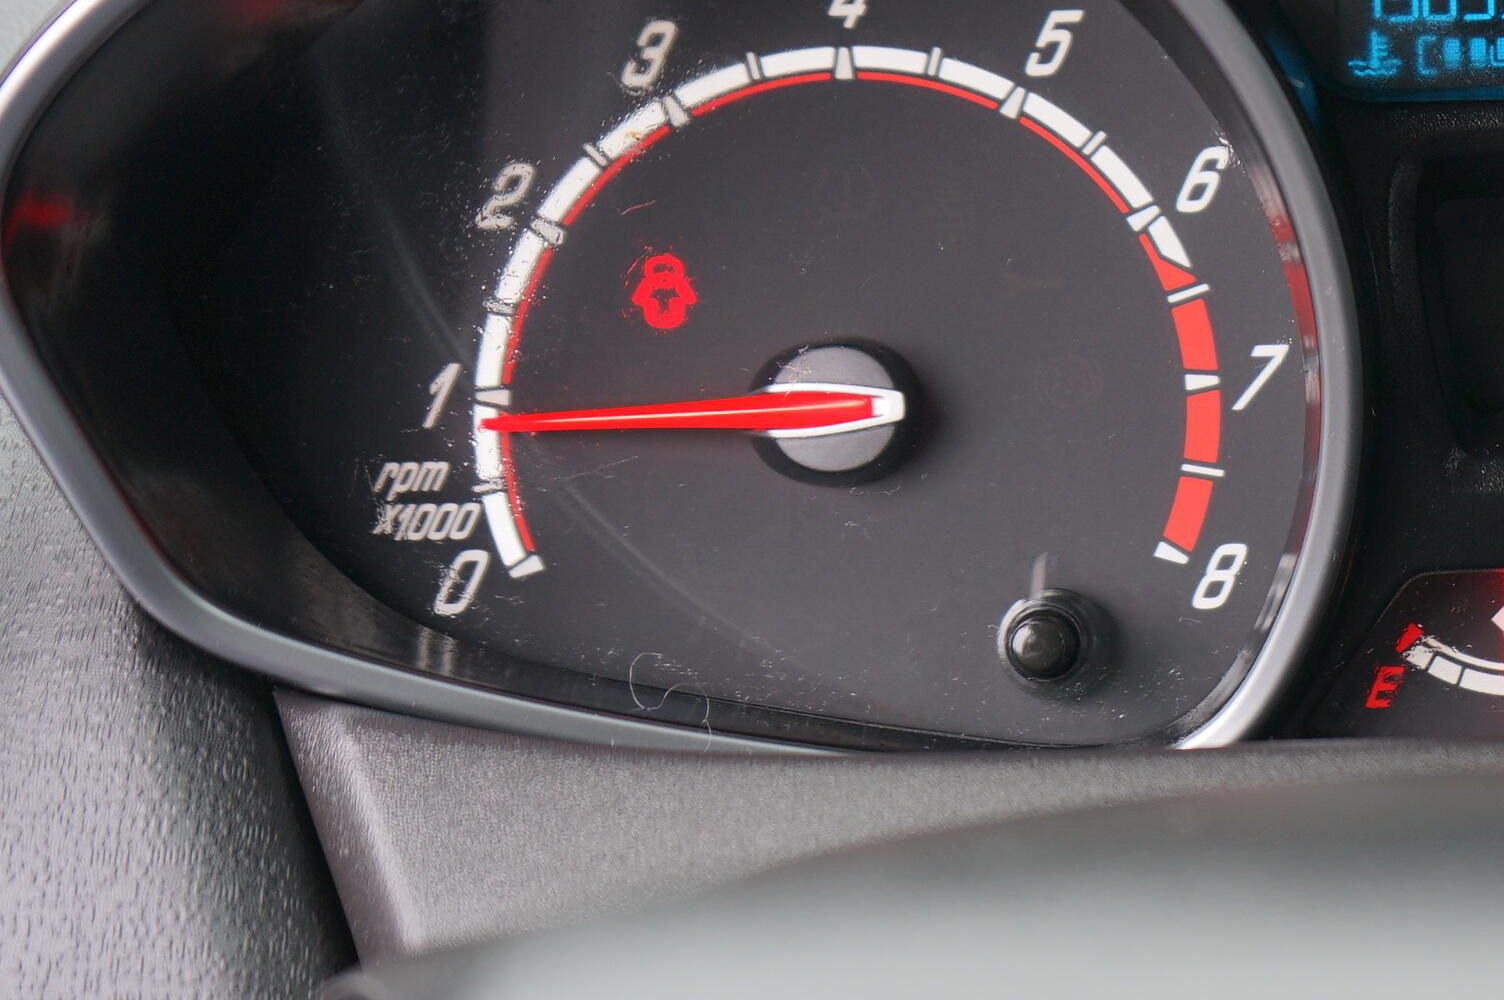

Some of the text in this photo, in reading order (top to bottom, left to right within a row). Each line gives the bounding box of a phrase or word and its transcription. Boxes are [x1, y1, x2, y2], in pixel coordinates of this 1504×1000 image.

[622, 19, 678, 92] 3
[1025, 9, 1084, 77] 5
[474, 162, 536, 230] 2
[1176, 145, 1230, 213] 6
[422, 362, 462, 429] 1
[1231, 344, 1290, 411] 7
[374, 461, 450, 501] rpm
[433, 549, 490, 617] 0
[1191, 543, 1248, 610] 8
[1364, 666, 1405, 708] E
